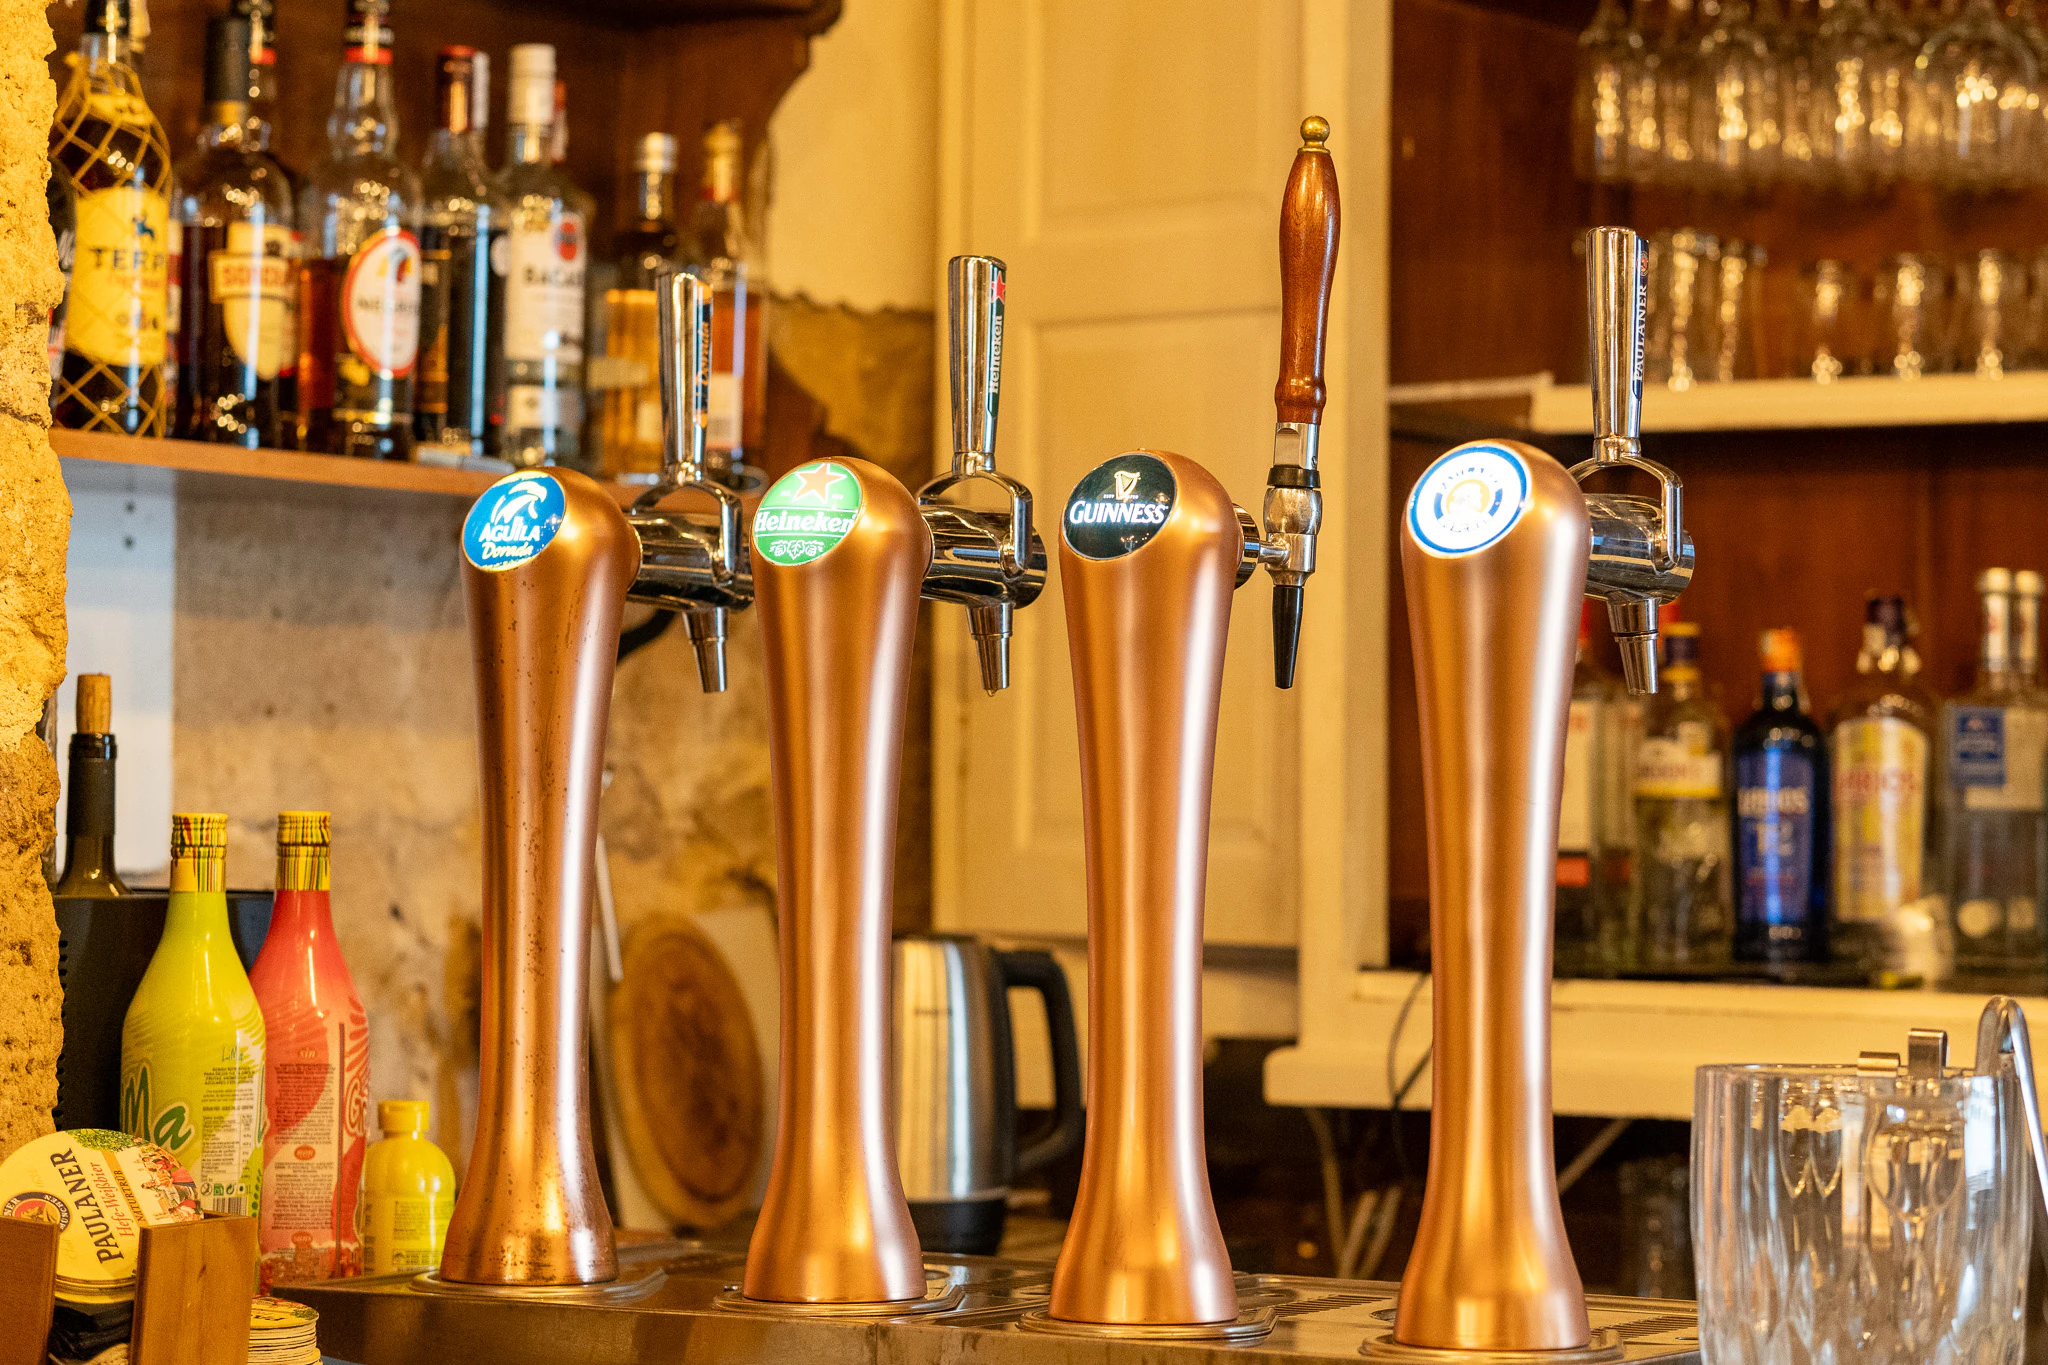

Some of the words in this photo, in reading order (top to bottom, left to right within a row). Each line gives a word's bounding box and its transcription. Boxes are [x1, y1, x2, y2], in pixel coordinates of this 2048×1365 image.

[989, 315, 1003, 394] Heineken
[1633, 284, 1648, 382] PAULANER
[481, 541, 534, 560] Dorada
[1069, 500, 1166, 524] GUINNESS
[50, 1148, 124, 1264] PAULANER
